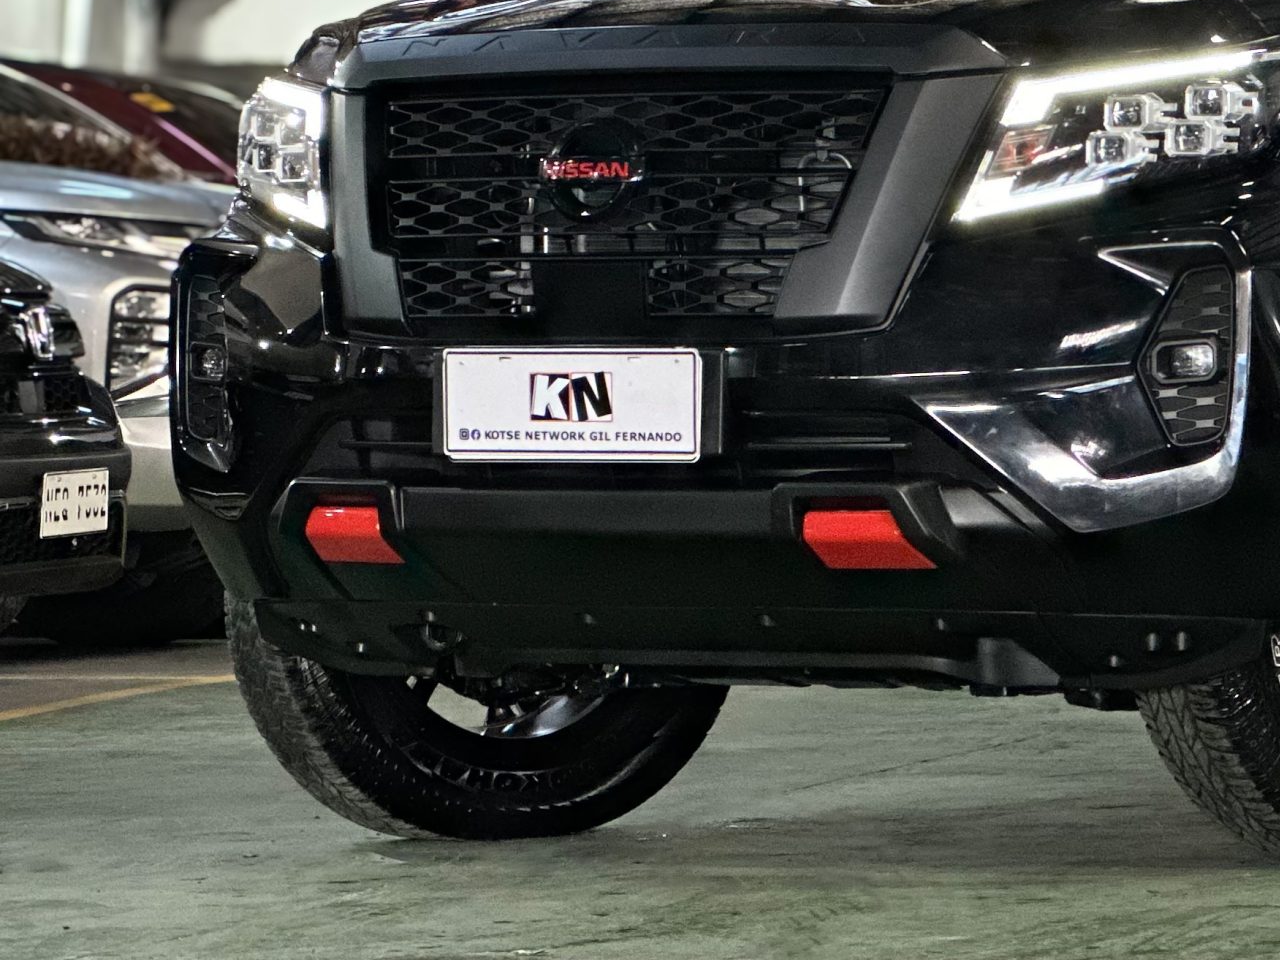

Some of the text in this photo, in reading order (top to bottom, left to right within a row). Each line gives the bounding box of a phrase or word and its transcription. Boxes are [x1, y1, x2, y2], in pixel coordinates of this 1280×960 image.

[531, 371, 613, 422] KN
[484, 430, 682, 442] KOTSE NETWORK GIL FERNANDO
